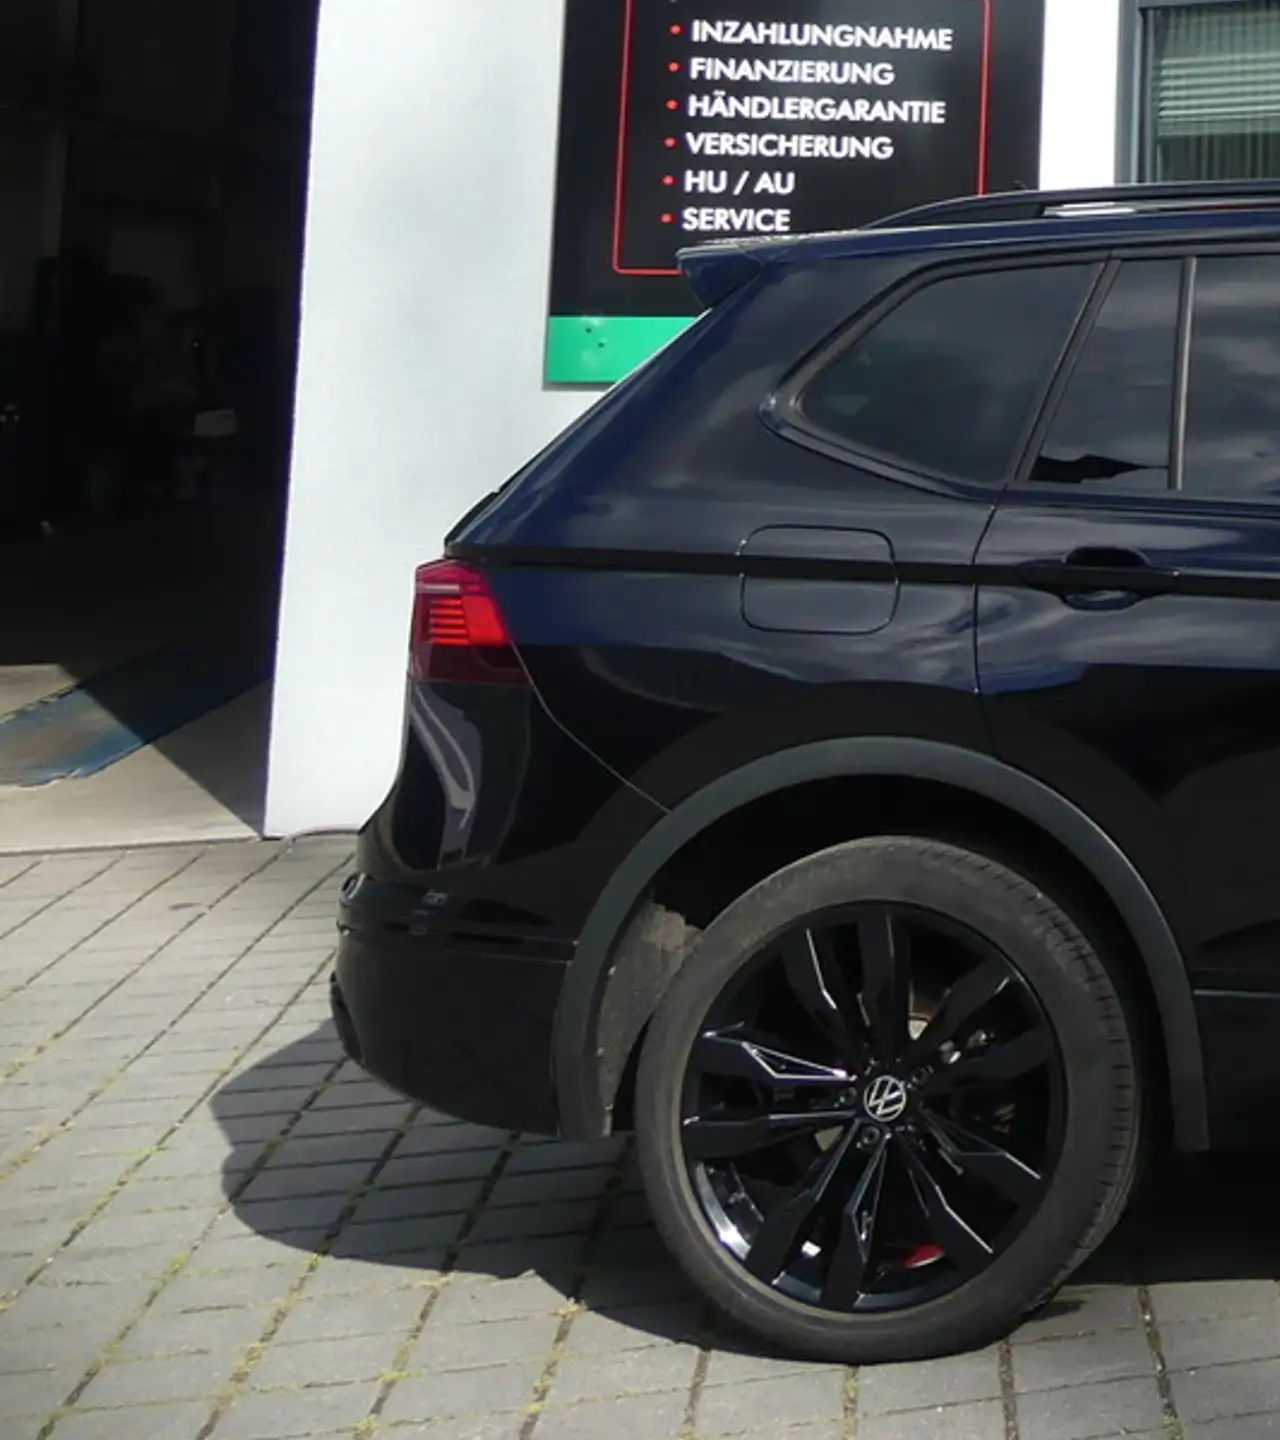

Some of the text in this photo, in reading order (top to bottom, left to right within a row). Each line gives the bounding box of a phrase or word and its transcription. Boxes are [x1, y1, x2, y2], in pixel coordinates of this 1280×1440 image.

[690, 18, 954, 51] INZAHLUNGNAHME
[688, 56, 897, 86] FINANZIERUNG
[686, 89, 947, 124] HÄNDLERGARANTIE
[685, 131, 895, 160] VERSICHERUNG
[683, 169, 729, 194] HU
[753, 171, 797, 195] AU
[681, 207, 792, 232] SERVICE
